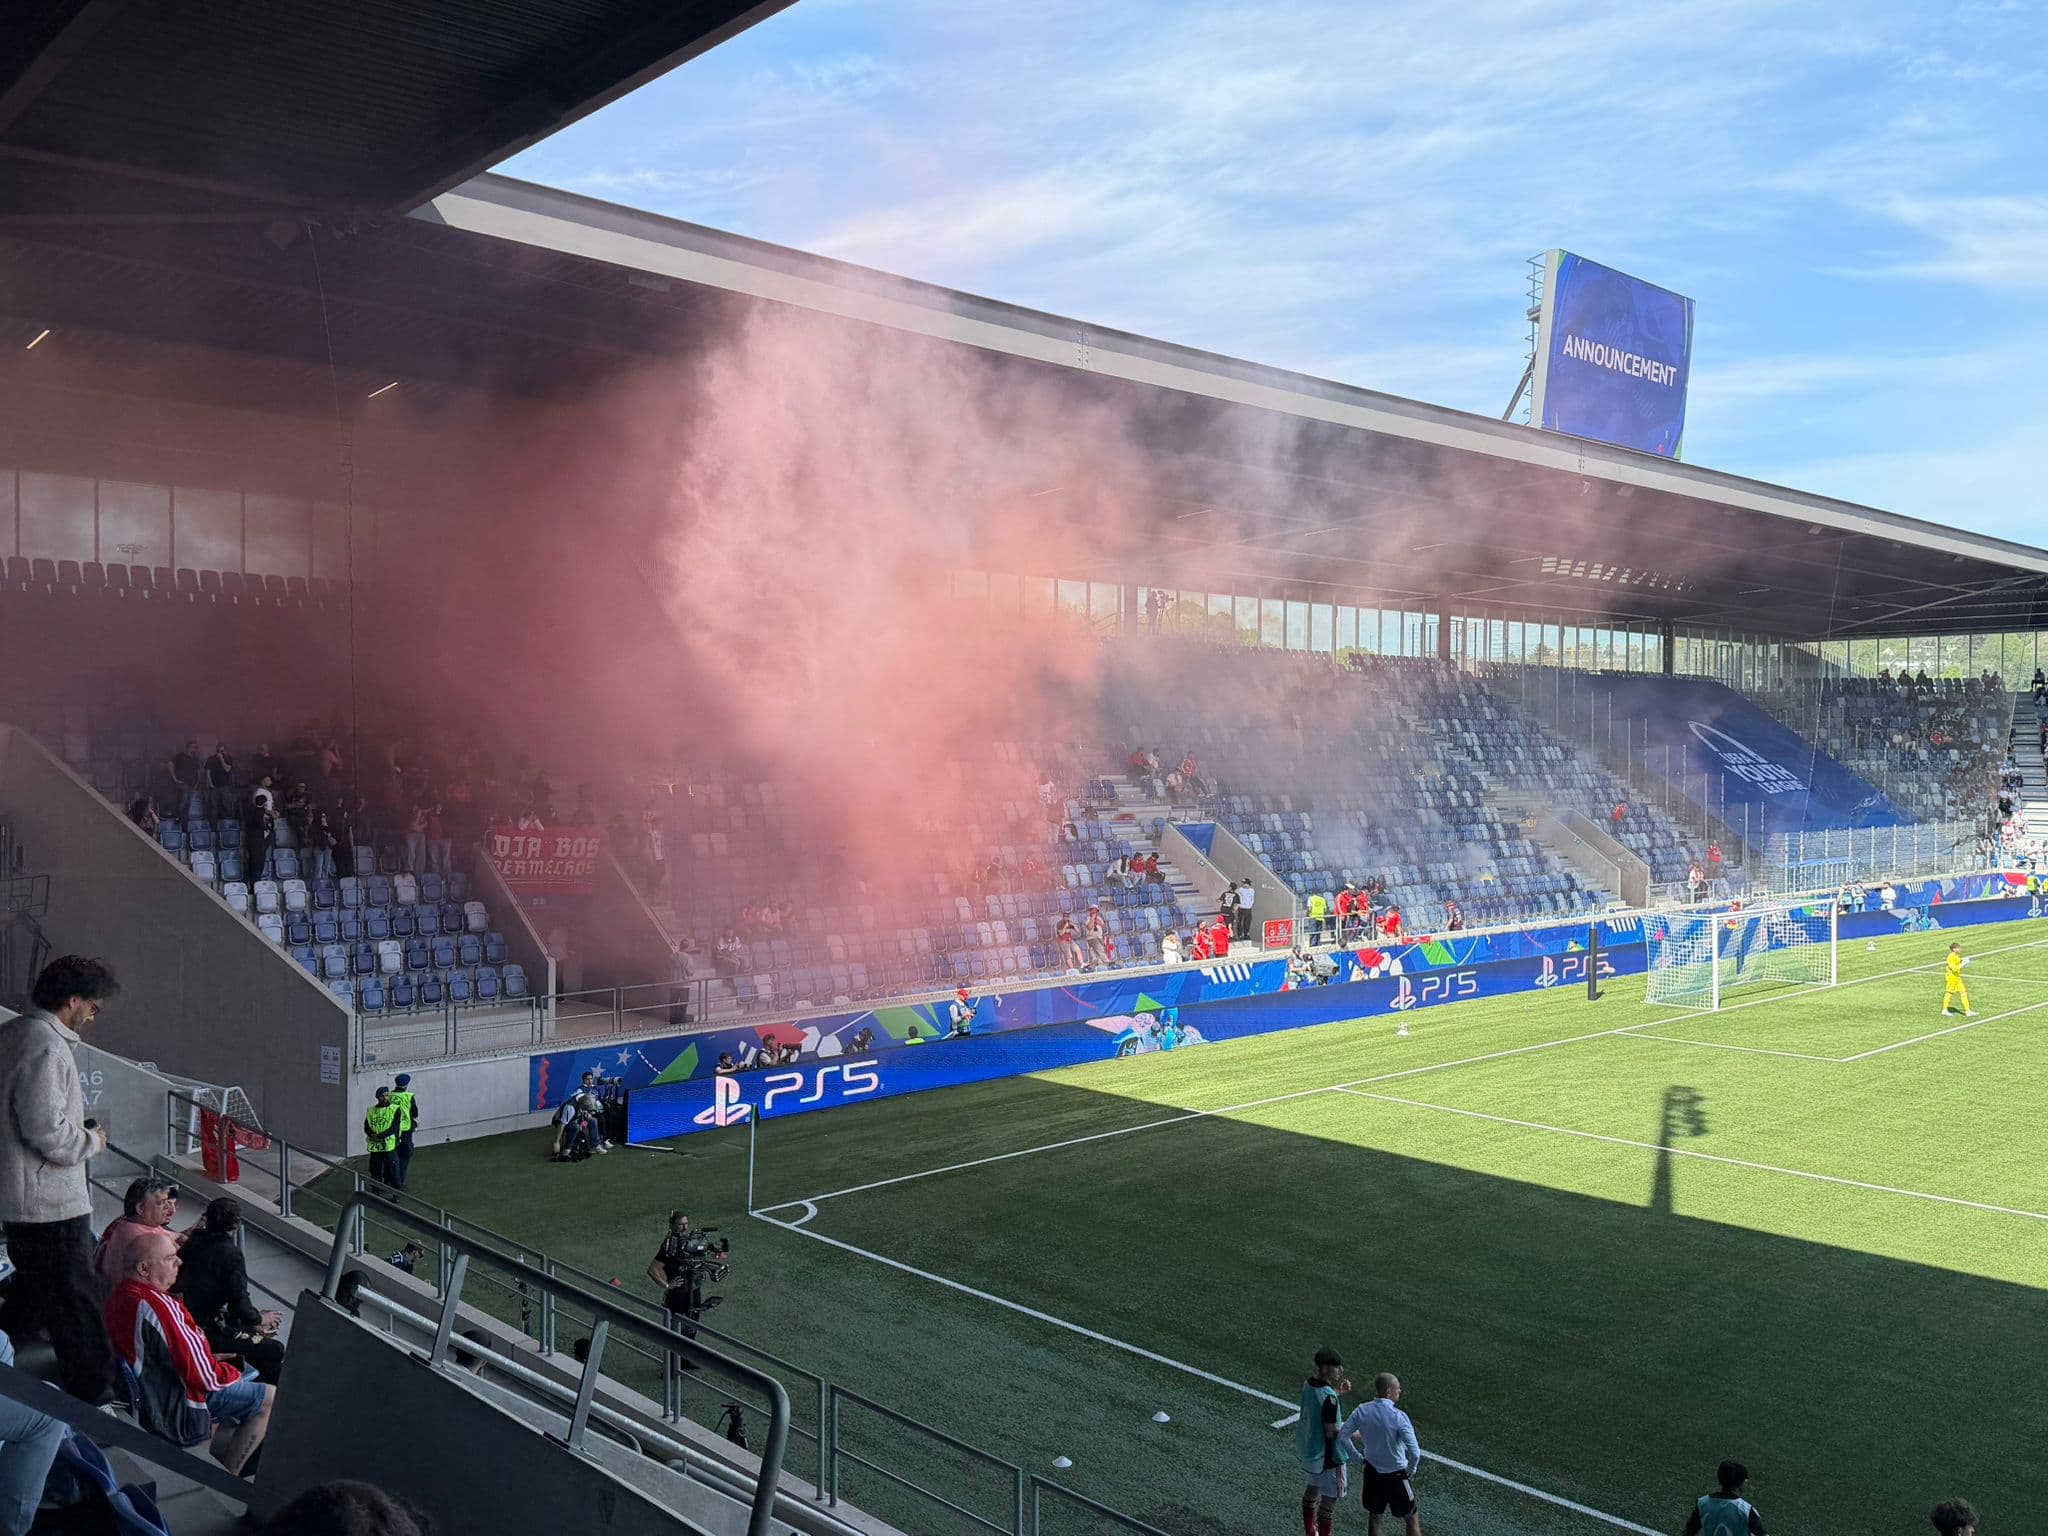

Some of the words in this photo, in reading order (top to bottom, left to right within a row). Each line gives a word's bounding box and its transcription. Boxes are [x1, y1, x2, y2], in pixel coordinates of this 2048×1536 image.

[1563, 334, 1677, 387] ANNOUNCEMENT
[1719, 752, 1757, 765] UEFA
[1723, 764, 1800, 783] YOUTH
[554, 836, 601, 860] BOS
[1422, 970, 1477, 1001] PS5
[78, 1071, 104, 1086] A6
[765, 1059, 878, 1110] PS5
